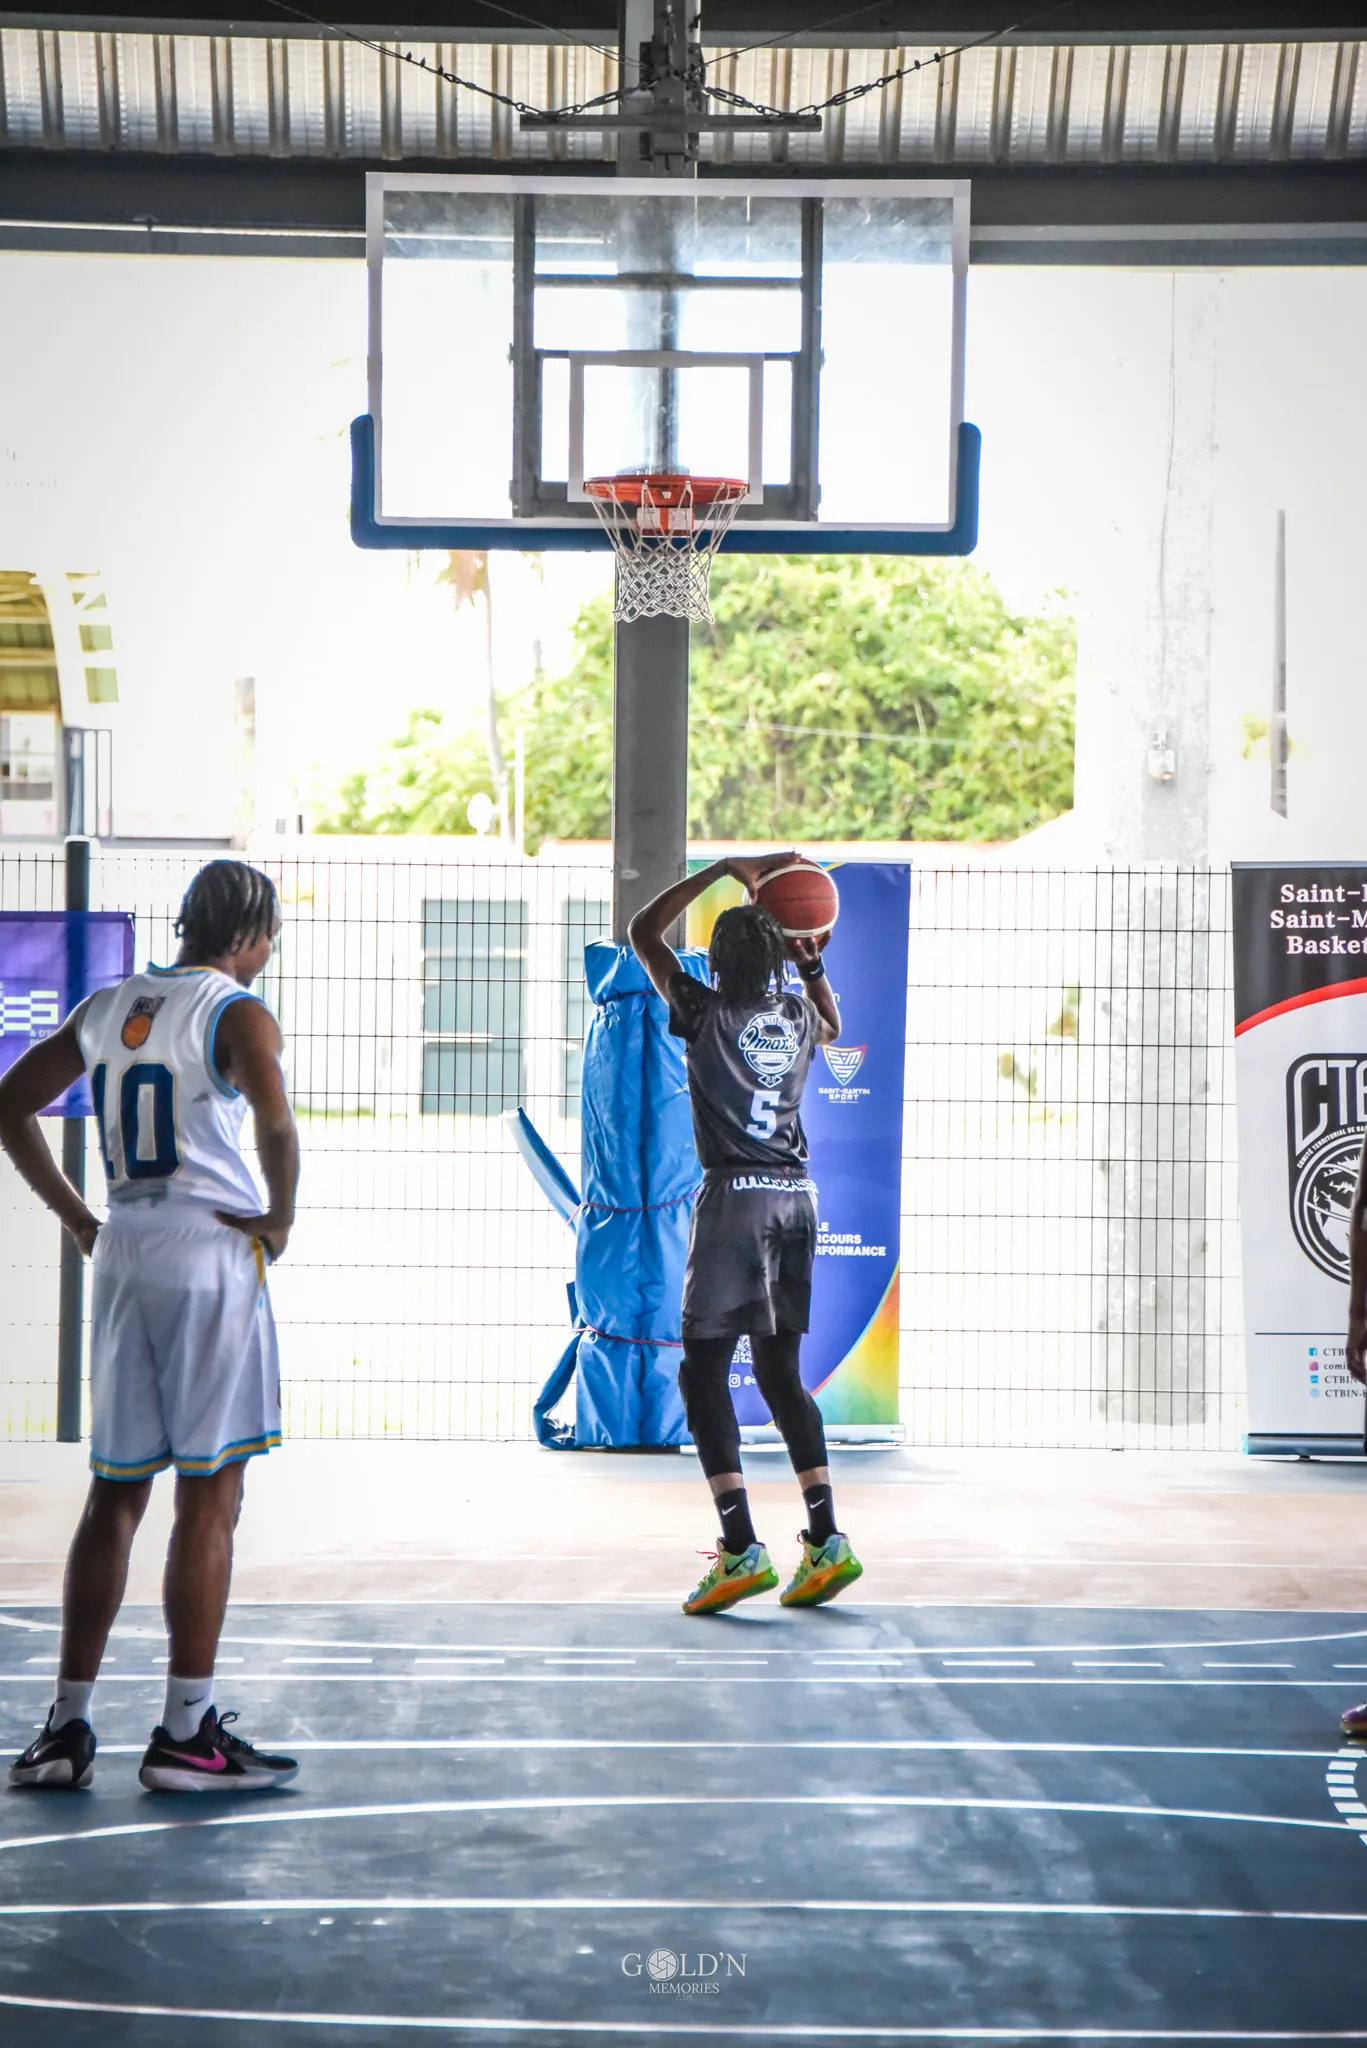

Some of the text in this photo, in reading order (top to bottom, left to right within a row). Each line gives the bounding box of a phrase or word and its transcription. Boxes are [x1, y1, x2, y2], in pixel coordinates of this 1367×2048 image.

[1270, 910, 1367, 928] Saint-M
[91, 1062, 182, 1180] 10
[746, 1090, 781, 1140] 5
[815, 1246, 887, 1256] RFORMANCE
